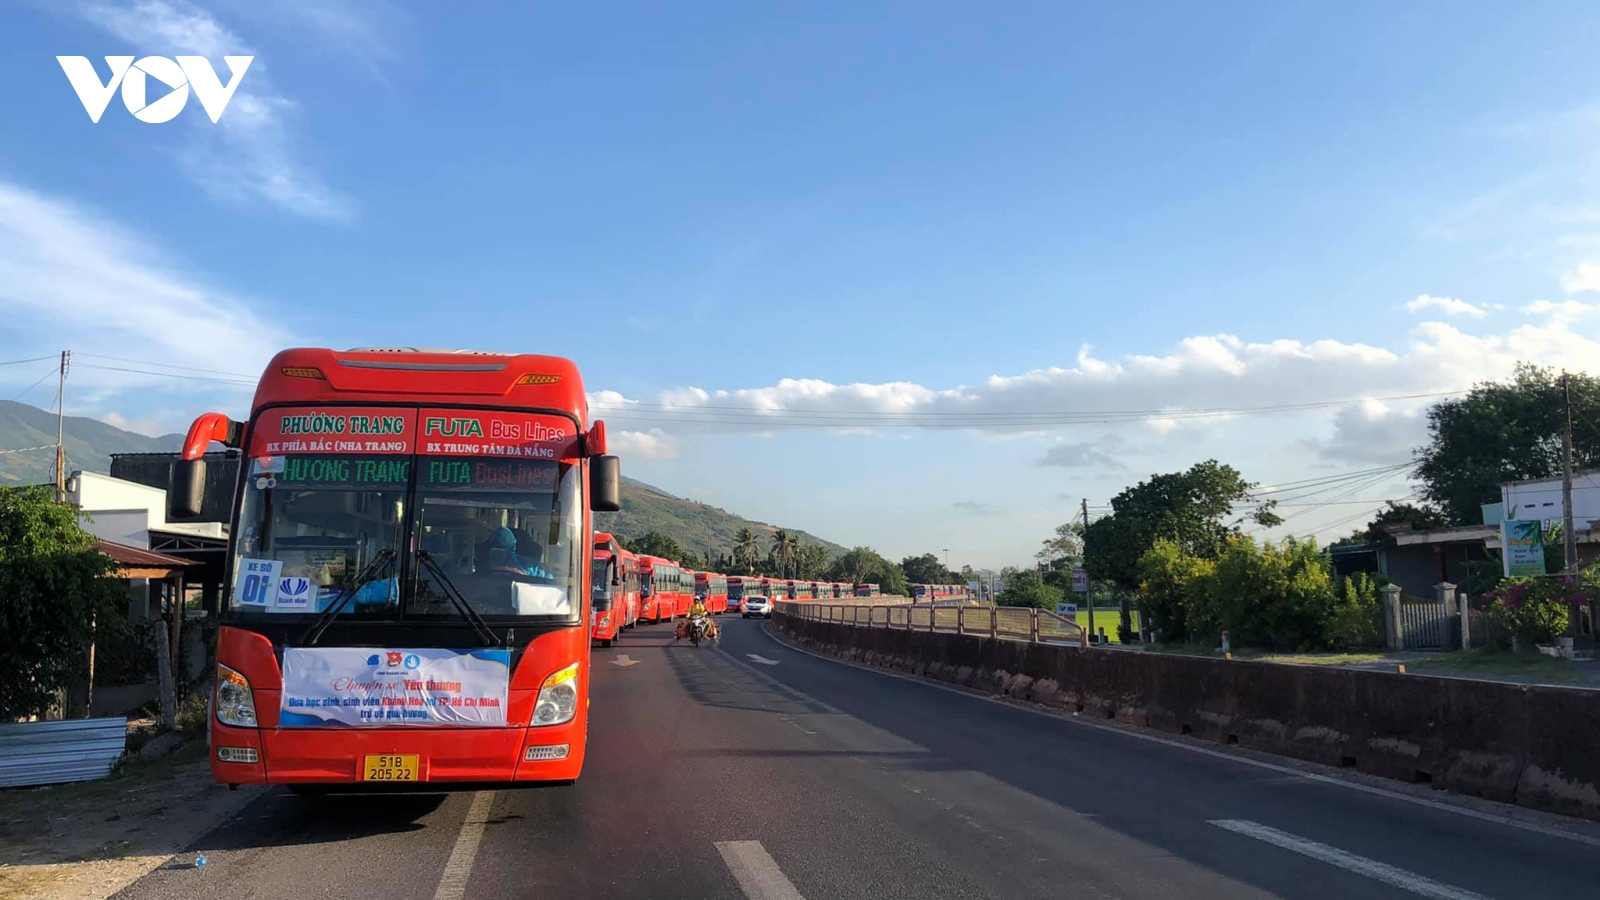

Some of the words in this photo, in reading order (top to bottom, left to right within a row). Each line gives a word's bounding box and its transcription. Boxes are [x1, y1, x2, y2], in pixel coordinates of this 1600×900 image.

[280, 411, 346, 434] PHƯƠNG
[349, 416, 405, 434] TRANG
[425, 417, 484, 438] FUTA
[491, 420, 520, 439] Bus
[525, 421, 565, 443] Lines
[266, 443, 280, 452] BX
[282, 440, 307, 451] PHÍA
[310, 437, 332, 451] BẮC
[334, 441, 362, 451] (NHA
[365, 441, 407, 452] TRANG)
[427, 443, 441, 452] BX
[444, 443, 480, 453] TRUNG
[482, 443, 504, 455] TÂM
[524, 443, 554, 457] NẴNG
[284, 459, 350, 481] HƯƠNG
[429, 461, 471, 483] FUTA
[247, 562, 259, 571] XE
[260, 561, 273, 572] SỐ
[242, 574, 270, 603] 01
[387, 682, 399, 690] xe
[404, 679, 423, 690] Yêu
[305, 697, 321, 708] học
[343, 697, 360, 707] sinh
[362, 697, 380, 707] viên
[479, 697, 500, 707] Minh
[380, 756, 403, 768] 51B
[370, 768, 411, 780] 205.22
